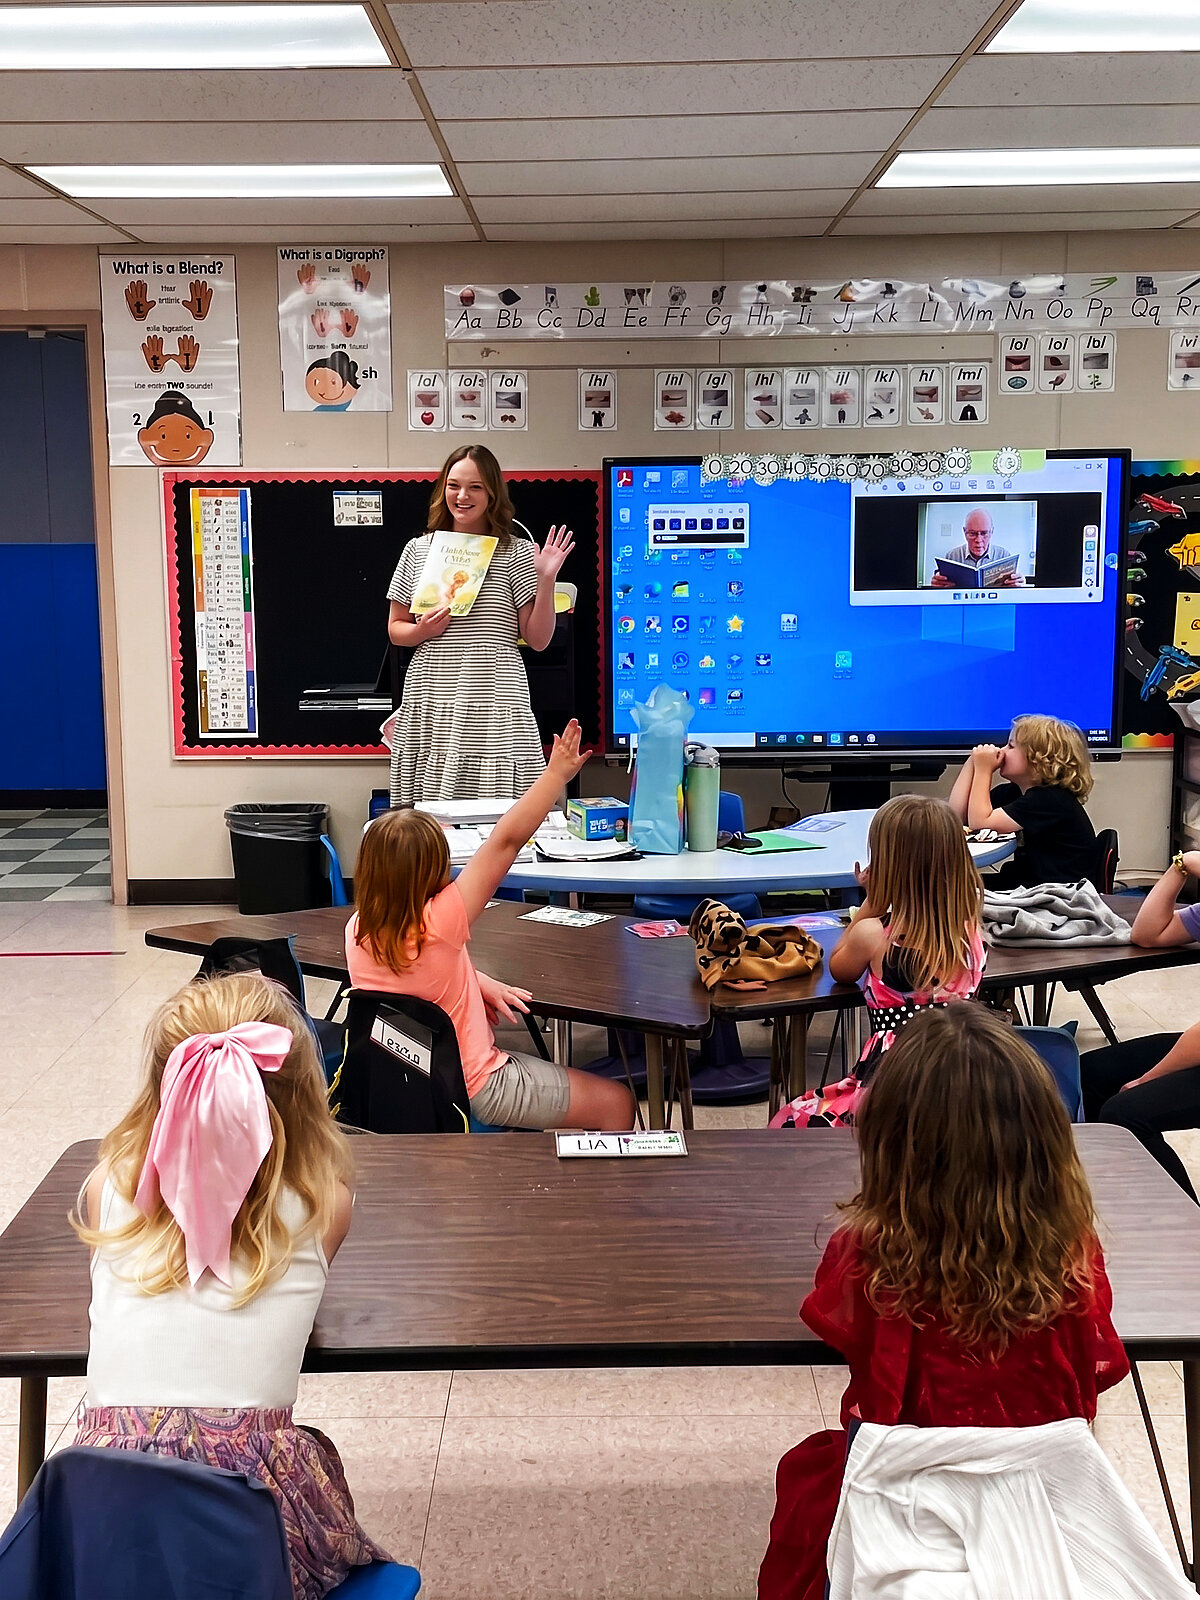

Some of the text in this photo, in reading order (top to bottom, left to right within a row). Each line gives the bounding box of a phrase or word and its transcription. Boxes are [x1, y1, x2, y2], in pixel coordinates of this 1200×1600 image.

[280, 249, 386, 263] What is a Digraph?
[112, 261, 223, 275] What is a Blend?
[454, 309, 482, 329] Aa
[497, 309, 523, 329] Bb
[537, 308, 562, 328] Cc
[577, 308, 606, 328] Dd
[623, 307, 648, 327] Ee
[664, 307, 691, 326] Ff
[706, 306, 732, 335] Gg
[747, 305, 774, 325] Hh
[833, 303, 856, 333] Jj
[872, 302, 899, 323] Kk
[955, 301, 994, 322] Mm
[1005, 300, 1034, 320] Nn
[1046, 299, 1073, 319] Oo
[1086, 298, 1113, 326] Pp
[1131, 297, 1160, 326] Qq
[362, 366, 378, 379] sh
[729, 459, 753, 474] 20
[758, 460, 780, 476] 30
[784, 461, 807, 475] 40
[809, 461, 831, 477] 50
[835, 462, 859, 477] 60
[862, 463, 885, 478] 70
[891, 457, 914, 473] 80
[918, 458, 941, 473] 90
[577, 1139, 608, 1151] LIA
